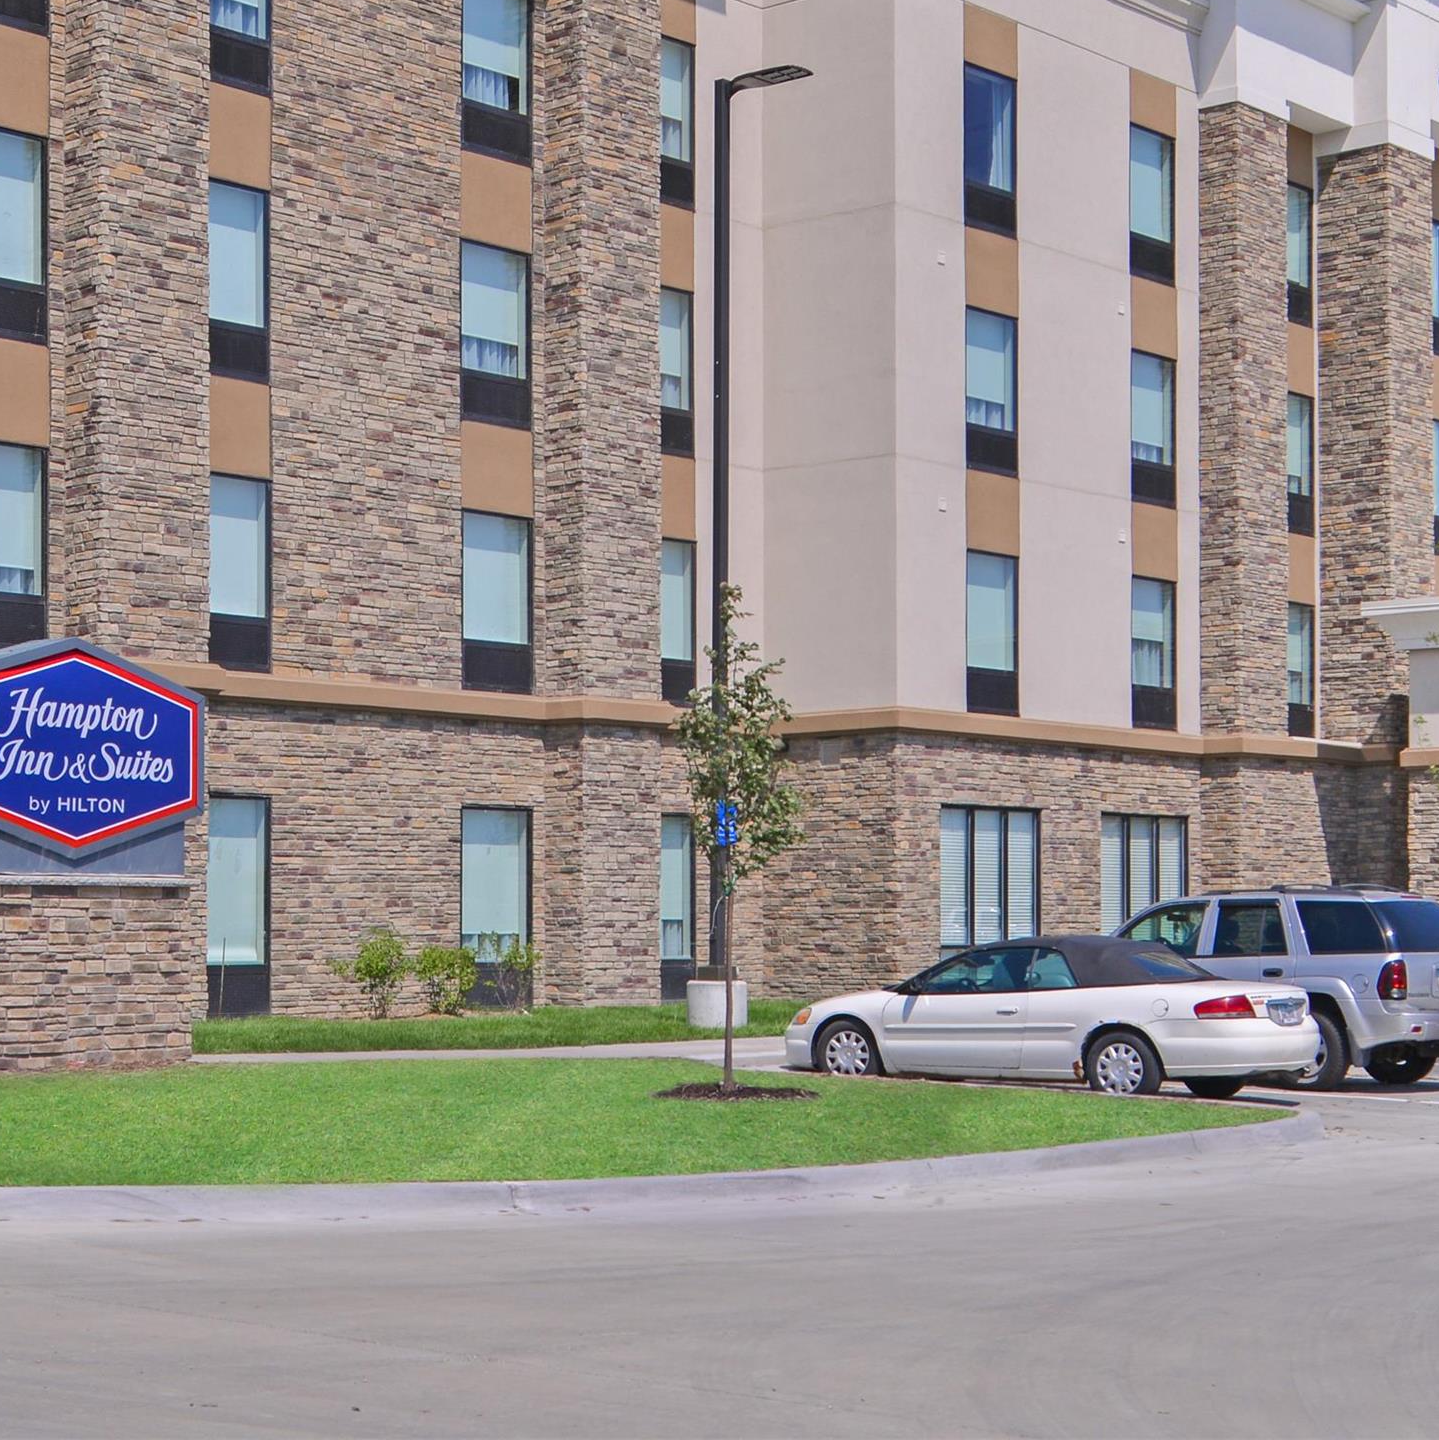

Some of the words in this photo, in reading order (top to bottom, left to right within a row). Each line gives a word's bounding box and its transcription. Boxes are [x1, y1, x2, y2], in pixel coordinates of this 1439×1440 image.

[68, 753, 91, 784] &
[88, 742, 174, 783] Suites
[28, 795, 51, 815] by
[57, 797, 125, 814] HILTON
